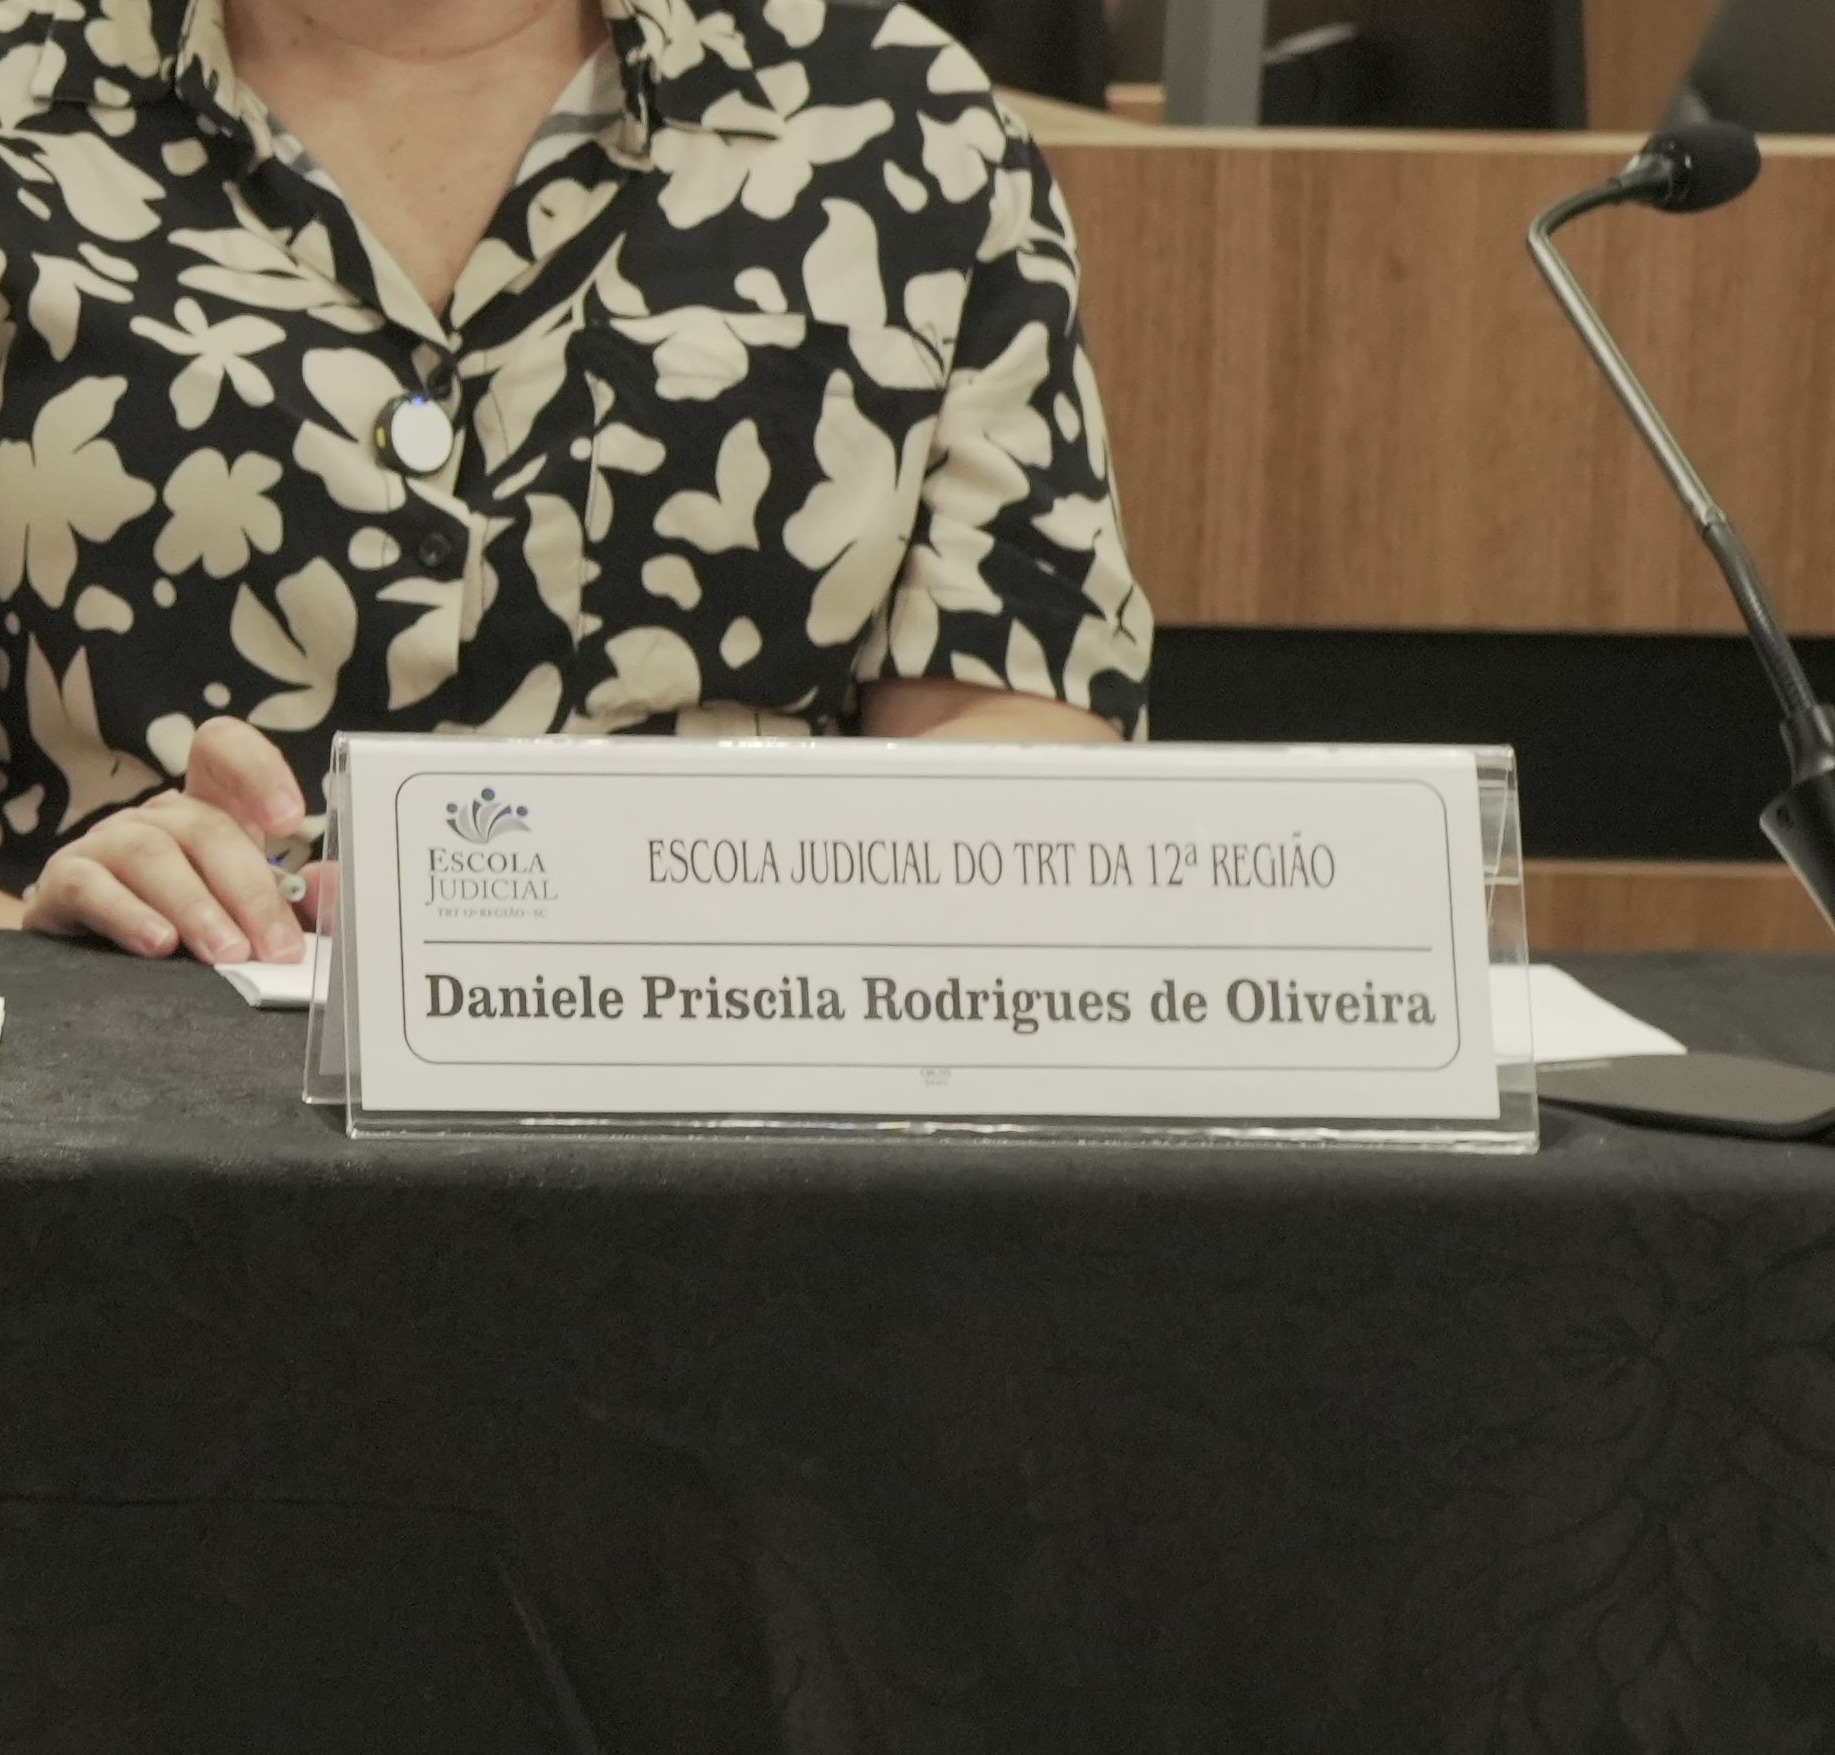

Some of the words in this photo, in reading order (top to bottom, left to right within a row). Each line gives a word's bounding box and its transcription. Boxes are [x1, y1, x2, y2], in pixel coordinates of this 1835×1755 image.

[427, 846, 547, 874] ESCOLA
[648, 839, 780, 884] ESCOLA
[790, 840, 941, 885] JUDICIAL
[953, 841, 1003, 886] DO
[1013, 842, 1076, 886] TRT
[1089, 842, 1133, 886] DA
[1149, 842, 1198, 887] 12ª
[1211, 832, 1336, 888] REGIÃO
[424, 874, 559, 907] JUDICIAL
[424, 974, 624, 1020] Daniele
[640, 975, 846, 1021] Priscila
[861, 976, 1132, 1035] Rodrigues
[1150, 978, 1208, 1024] de
[1226, 978, 1436, 1025] Oliveira
